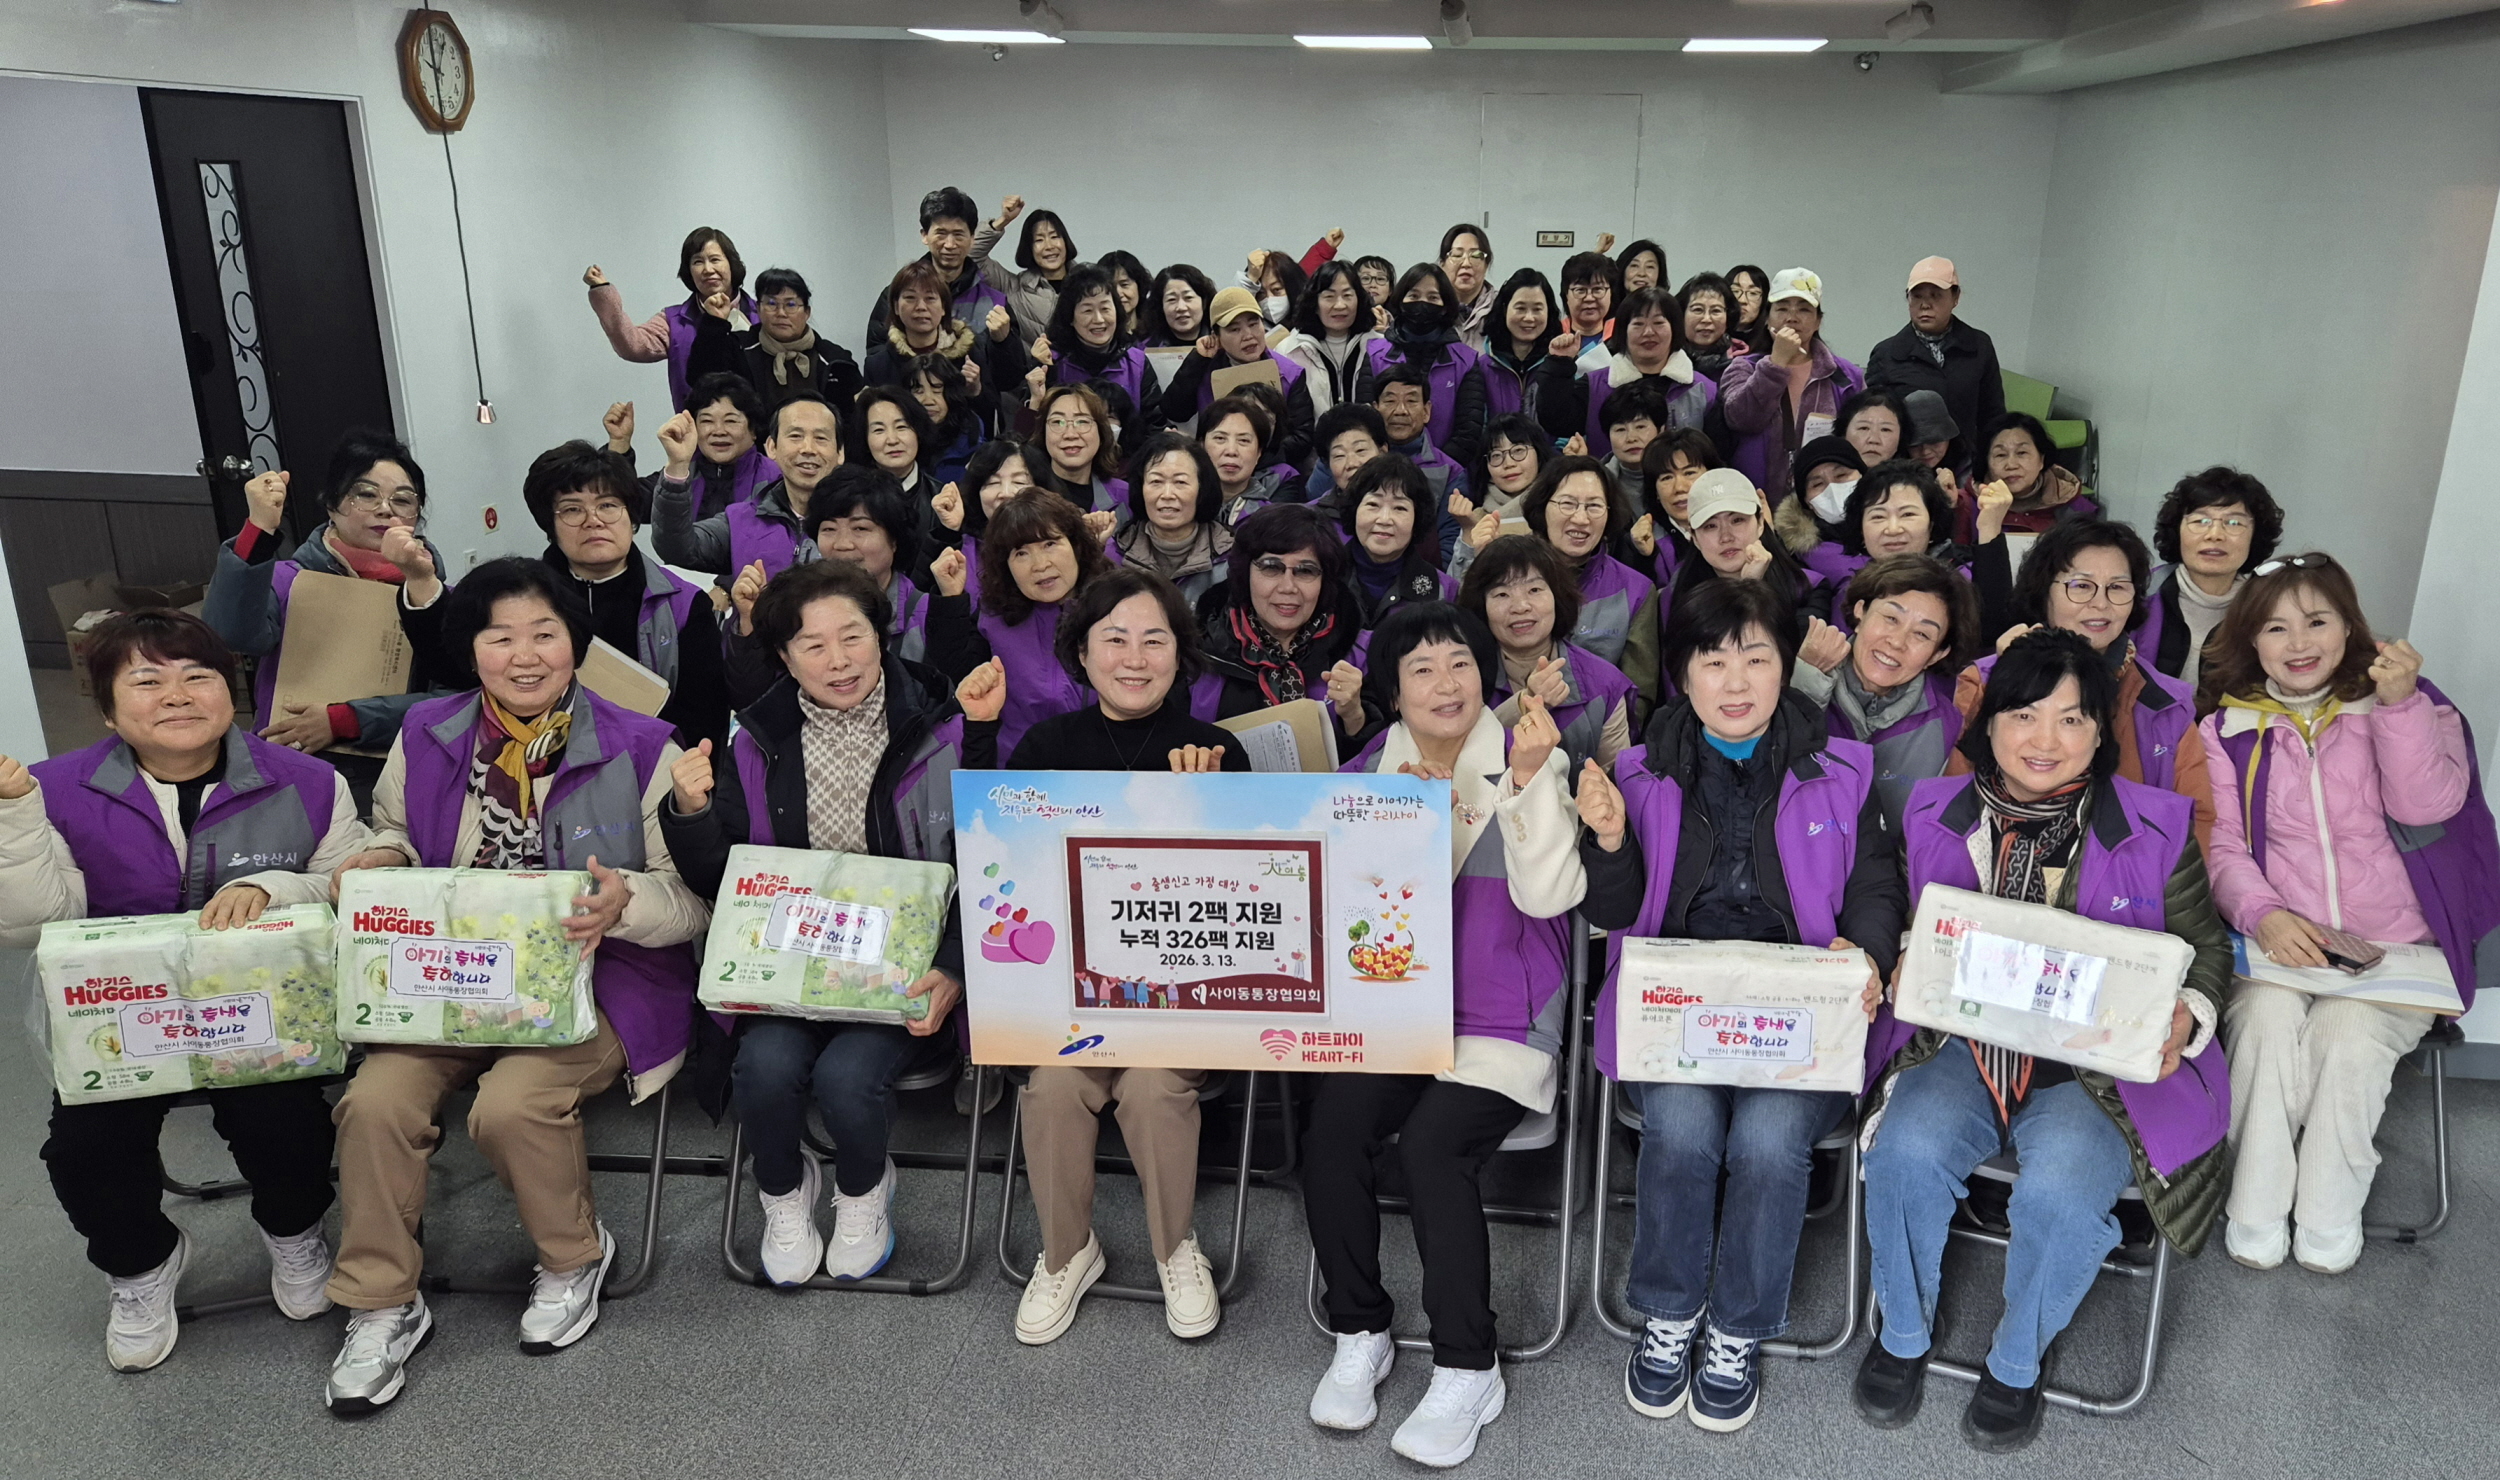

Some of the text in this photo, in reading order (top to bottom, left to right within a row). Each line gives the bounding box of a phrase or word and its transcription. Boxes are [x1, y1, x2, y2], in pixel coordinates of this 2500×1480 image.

[454, 65, 461, 80] 3
[453, 83, 459, 97] 4
[447, 96, 454, 109] 5
[1377, 794, 1424, 809] 이어가는
[1075, 804, 1105, 818] 안산
[1333, 808, 1417, 822] 따뜻한 우리사이
[252, 851, 298, 867] 안산시
[755, 872, 789, 884] 하기스
[1151, 876, 1240, 892] 출생신고 가정 대상
[371, 905, 409, 917] 하기스
[1111, 900, 1283, 925] 기저귀 2팩 지원
[353, 911, 435, 936] HUGGIES
[1120, 929, 1275, 951] 누적 326팩 지원
[405, 947, 451, 964] 아기의
[1160, 954, 1237, 967] 2026. 3. 13.
[422, 964, 491, 985] 축하합니다
[719, 961, 737, 982] 2
[84, 976, 132, 988] 하기스
[414, 984, 436, 993] 안산시
[64, 984, 168, 1005] HUGGIES
[1209, 986, 1321, 1003] 사이동통장협의회
[1642, 990, 1704, 1005] HUGGIES
[1655, 986, 1683, 994] 하기스
[137, 1007, 194, 1024] 아기의
[355, 1003, 371, 1025] 2
[1698, 1014, 1747, 1028] 아기의
[161, 1023, 246, 1039] 축하합니다
[1717, 1030, 1789, 1047] 축하합니다
[154, 1036, 244, 1051] 안산시 사이동통장협의회
[1302, 1032, 1363, 1047] 하트파이
[1302, 1051, 1363, 1063] HEART-FI
[83, 1070, 103, 1090] 2
